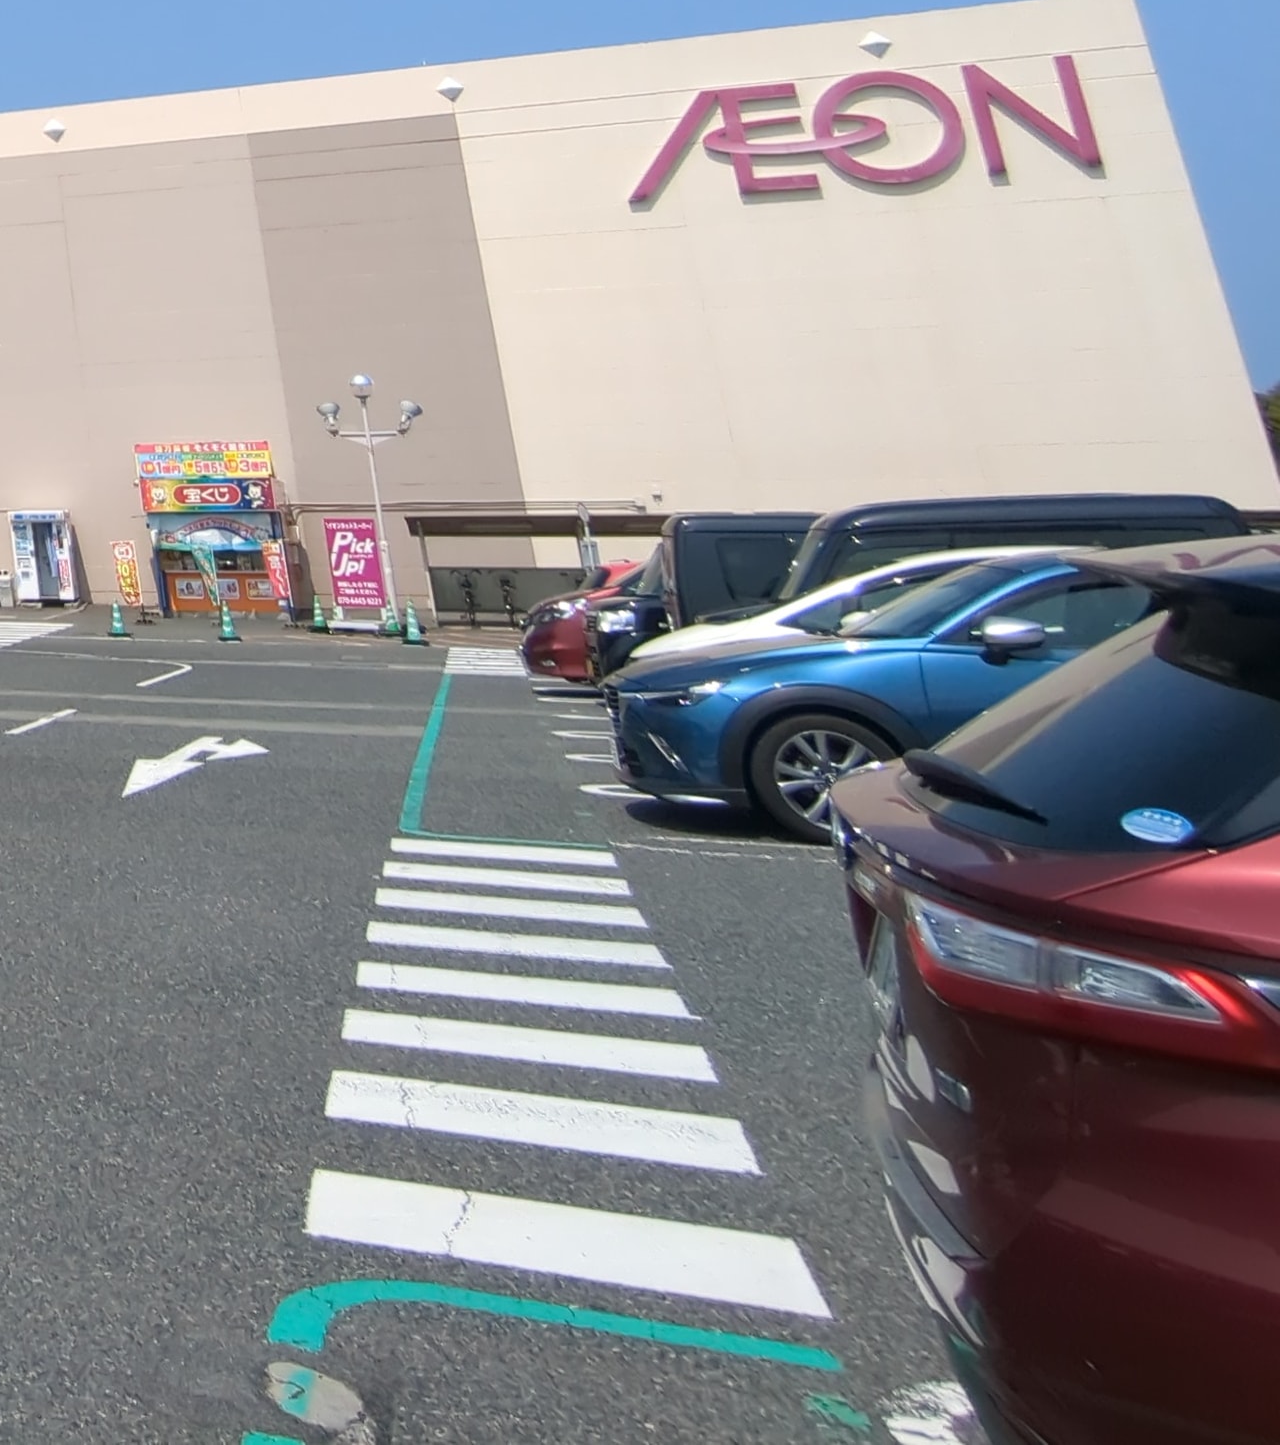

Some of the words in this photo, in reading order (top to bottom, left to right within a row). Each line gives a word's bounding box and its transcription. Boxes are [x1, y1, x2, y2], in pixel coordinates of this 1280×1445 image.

[183, 487, 230, 503] 宝くじ
[331, 532, 375, 554] Pick
[331, 553, 366, 577] Up!
